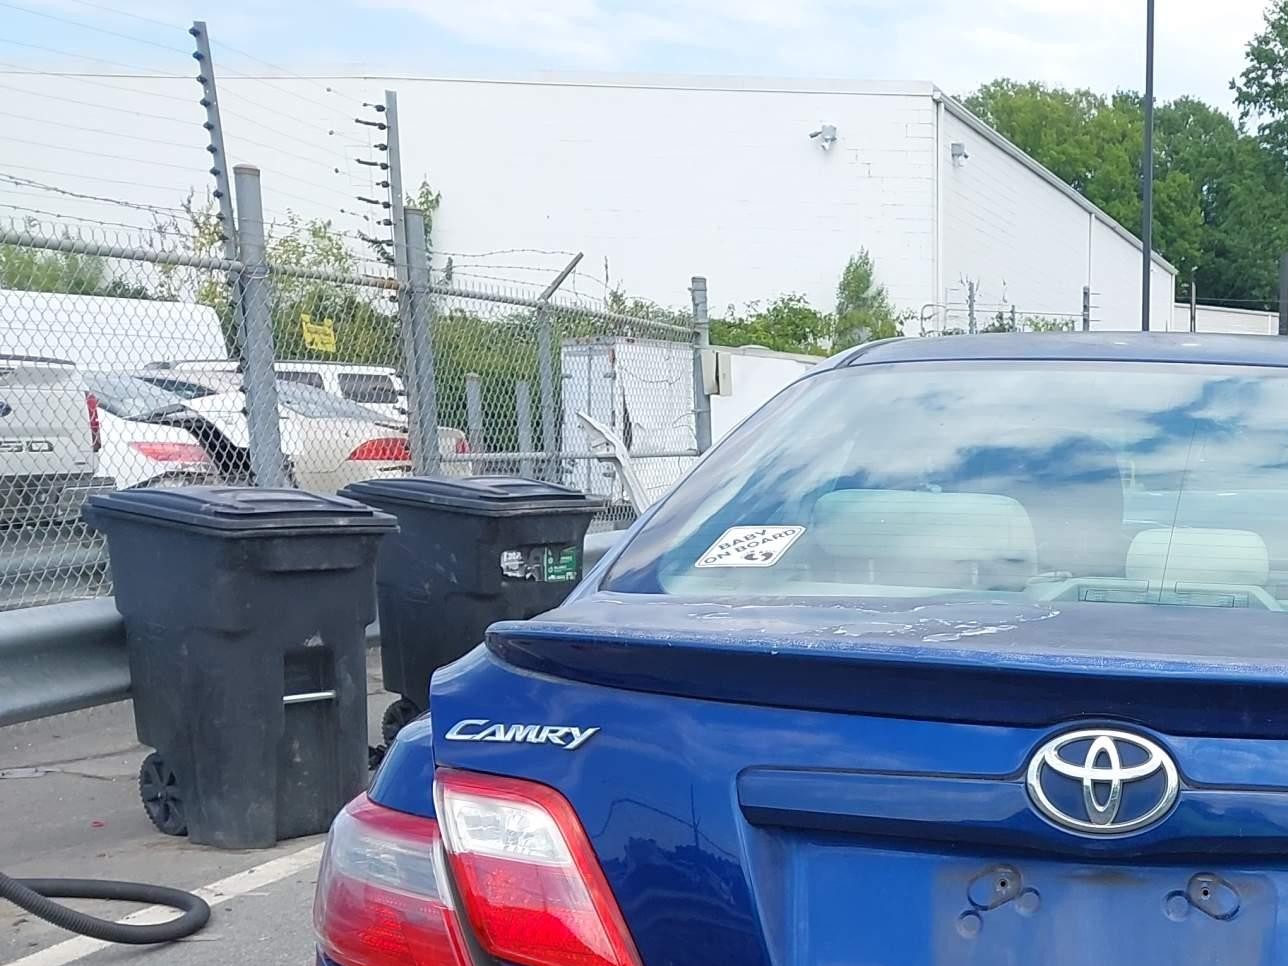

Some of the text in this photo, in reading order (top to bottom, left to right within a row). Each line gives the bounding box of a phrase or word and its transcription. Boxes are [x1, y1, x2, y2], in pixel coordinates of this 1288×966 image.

[703, 529, 796, 565] ON BOARD
[719, 529, 767, 551] BABY
[445, 719, 601, 751] CAMRY
